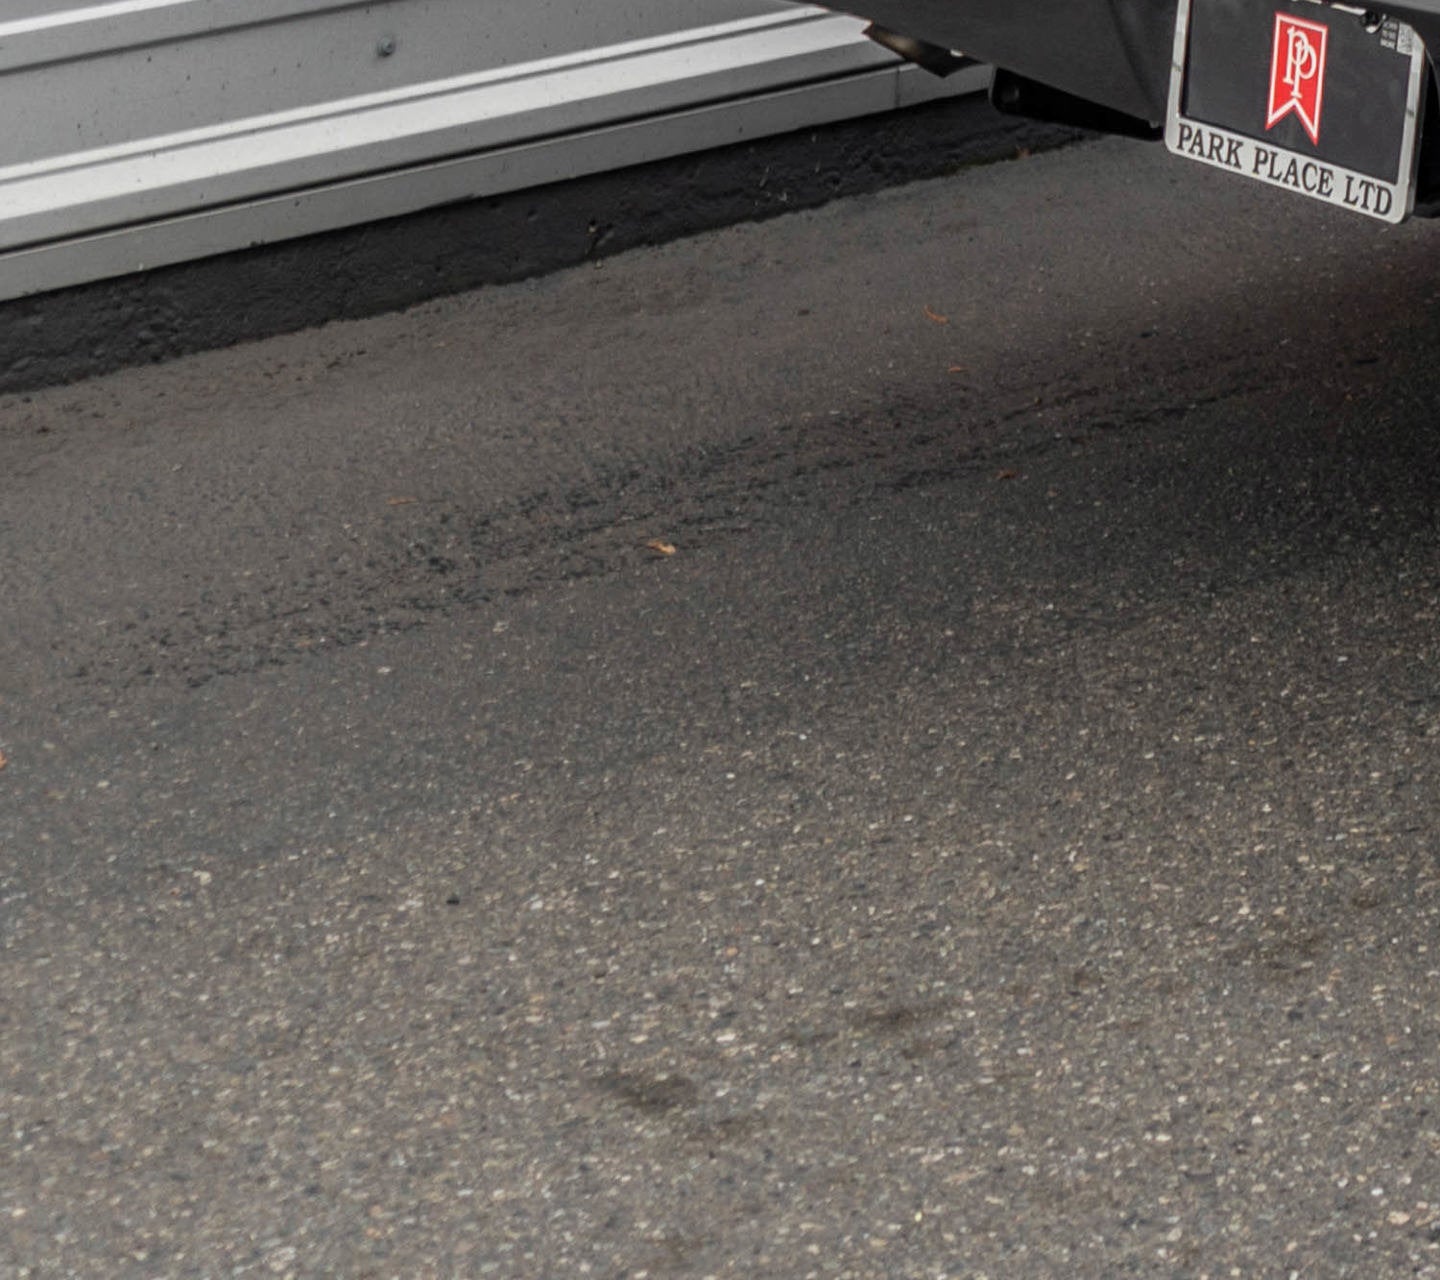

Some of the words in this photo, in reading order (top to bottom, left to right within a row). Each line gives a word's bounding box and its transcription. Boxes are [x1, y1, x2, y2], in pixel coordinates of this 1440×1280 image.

[1176, 122, 1243, 170] PARK
[1251, 147, 1334, 197] PLACE
[1344, 175, 1393, 216] LTD
